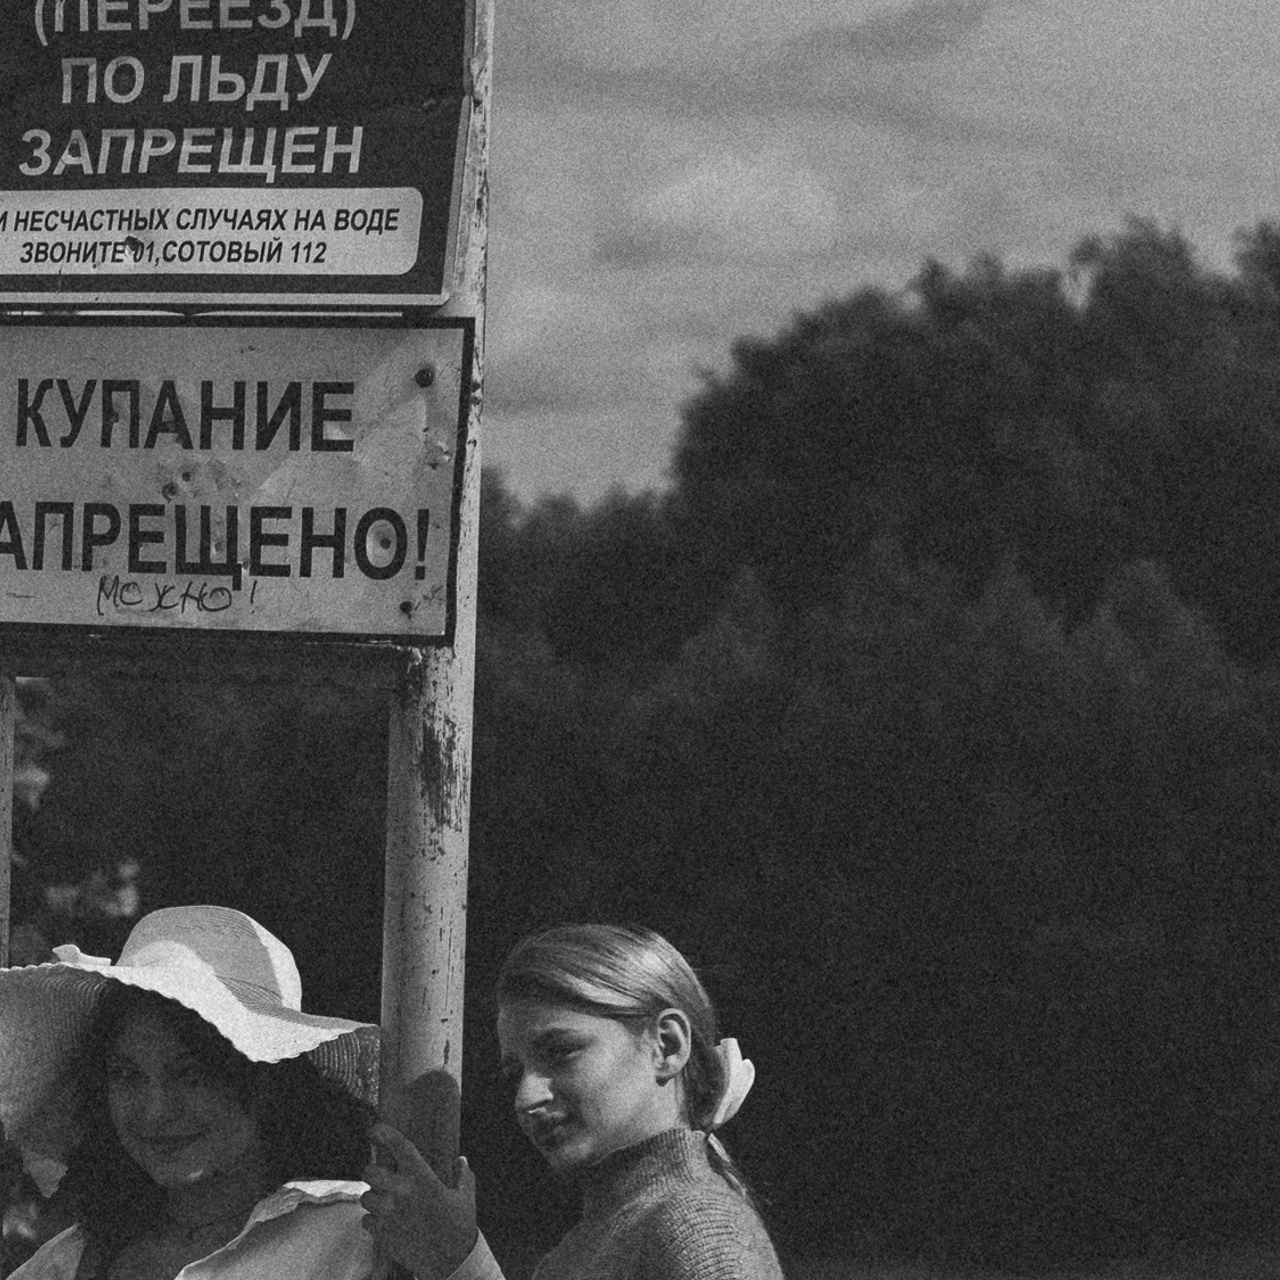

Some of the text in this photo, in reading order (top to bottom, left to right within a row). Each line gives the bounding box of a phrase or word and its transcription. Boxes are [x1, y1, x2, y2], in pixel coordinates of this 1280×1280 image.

[35, 0, 356, 46] (ПЕРЕЕЗД)
[61, 53, 333, 111] ПО ЛЬДУ
[19, 125, 364, 183] ЗАПРЕЩЕН
[13, 208, 171, 232] НЕСЧАСТНЫХ
[176, 208, 288, 231] СЛУЧАЯХ
[293, 208, 326, 232] НА
[333, 208, 401, 235] ВОДЕ
[19, 241, 126, 264] ЗВОНИТЕ
[290, 241, 328, 264] 112
[16, 377, 355, 453] КУПАНИЕ
